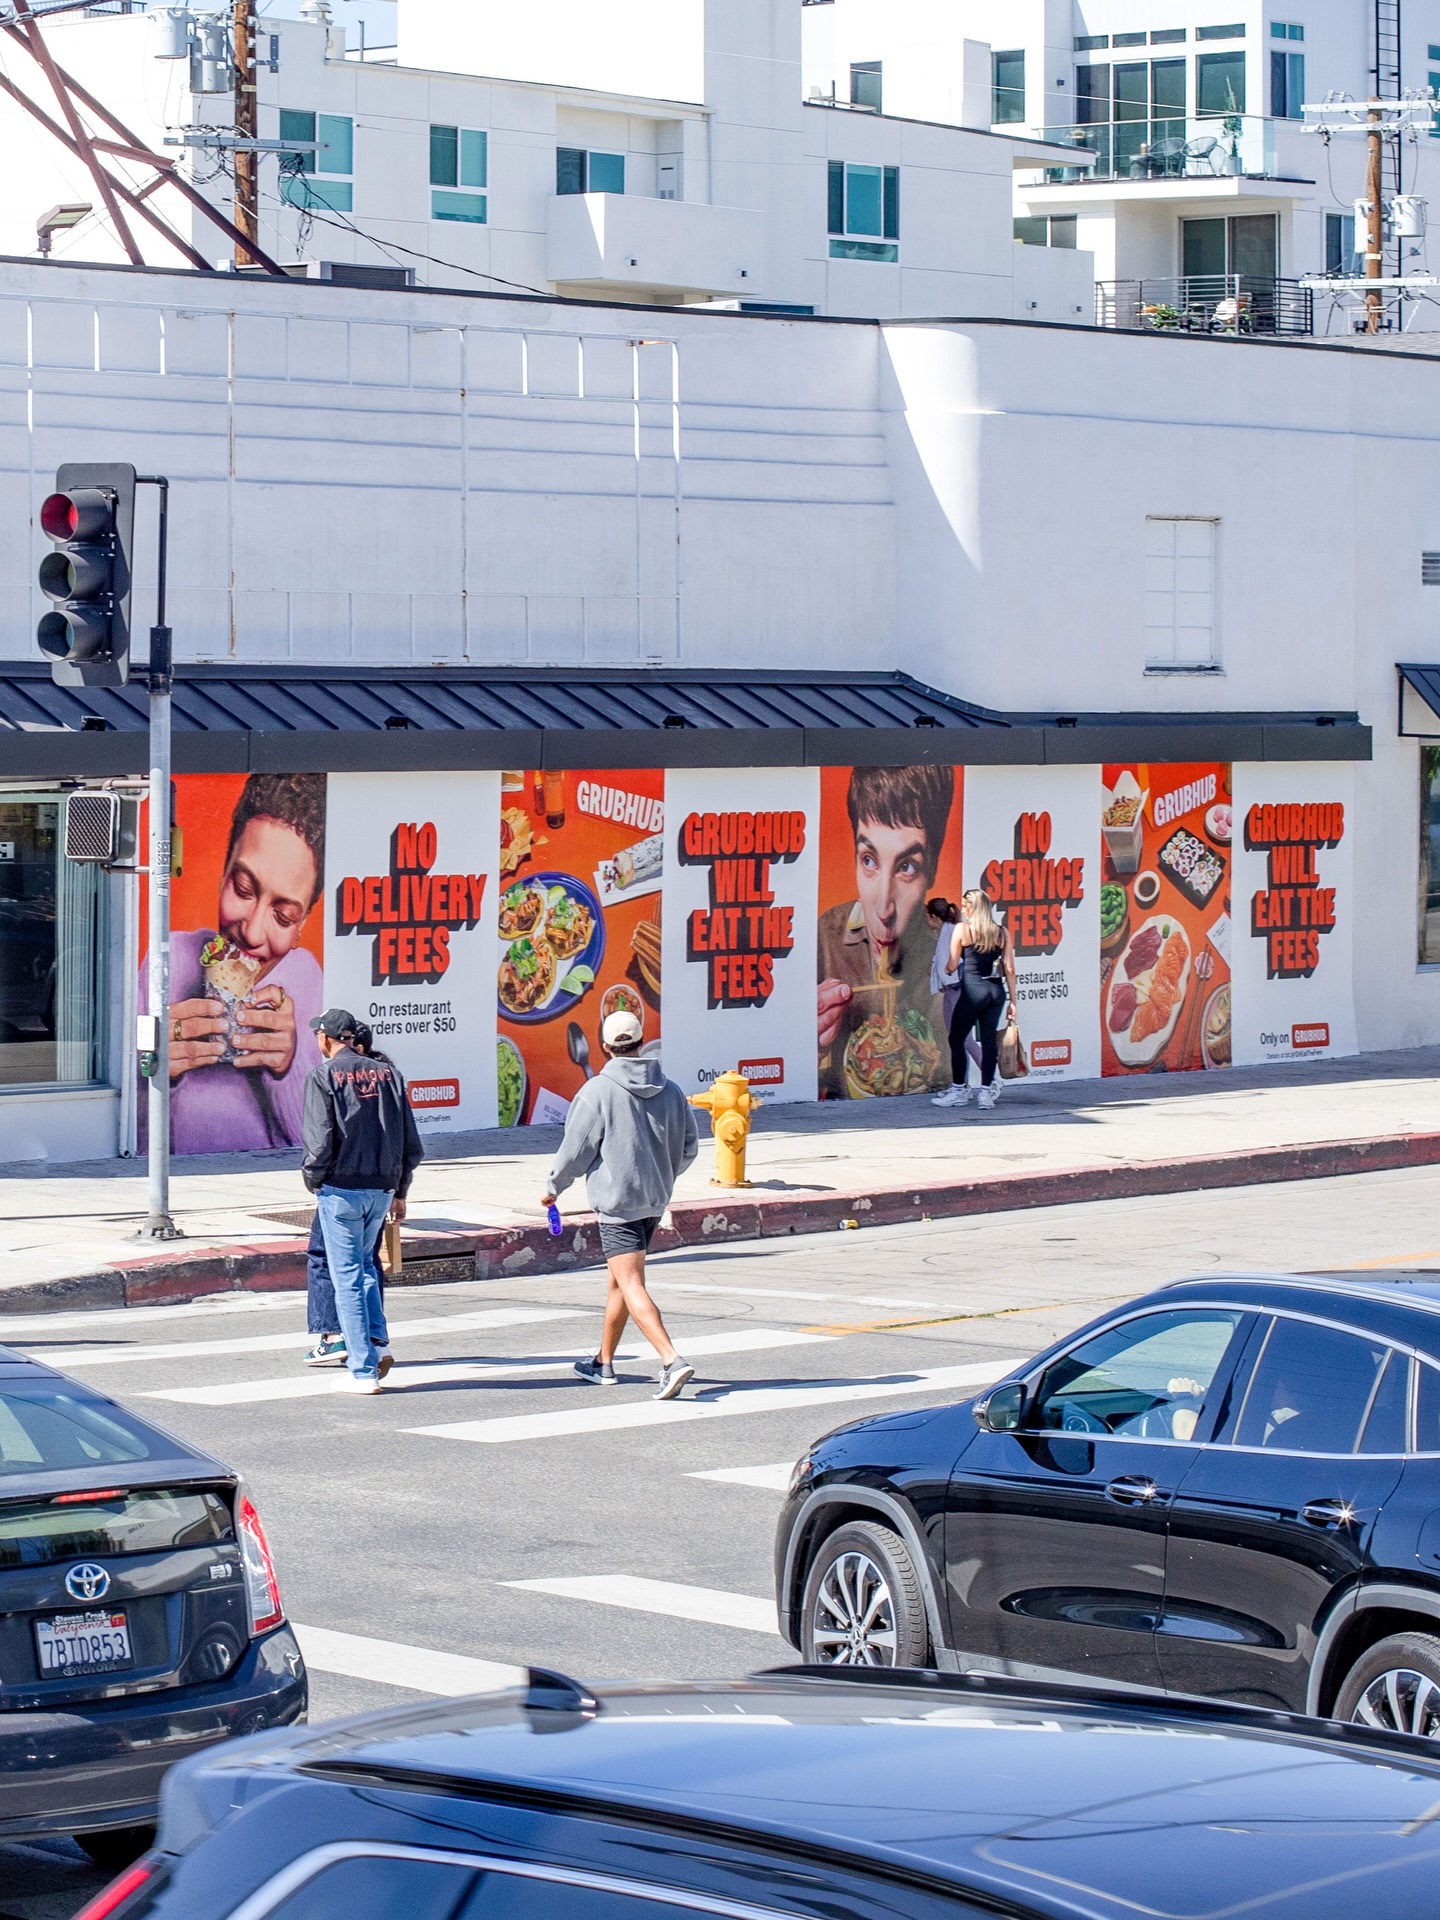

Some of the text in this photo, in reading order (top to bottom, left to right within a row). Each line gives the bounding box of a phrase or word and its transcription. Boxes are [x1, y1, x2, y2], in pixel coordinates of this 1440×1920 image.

[577, 780, 664, 832] GRUBHUB
[1154, 773, 1216, 826] GRUBHUB
[682, 811, 806, 856] GRUBHUB
[1019, 811, 1052, 854] NO
[1248, 803, 1344, 842] GRUBHUB
[395, 821, 438, 870] NO
[1270, 845, 1320, 884] WILL
[341, 873, 488, 925] DELIVERY
[713, 859, 775, 903] WILL
[985, 857, 1085, 903] SERVICE
[1007, 904, 1063, 947] FEES
[1254, 888, 1336, 928] EAT THE
[690, 906, 795, 952] EAT THE
[376, 925, 451, 975] FEES
[1270, 929, 1320, 970] FEES
[712, 953, 774, 999] FEES
[1016, 970, 1064, 985] restaurant
[1028, 988, 1049, 1000] over
[1050, 984, 1068, 1000] $50
[369, 1000, 451, 1018] On restaurant
[371, 1016, 456, 1035] rders over $50
[1034, 1045, 1068, 1060] GRUBHUB
[1260, 1029, 1326, 1047] Only on GRUBHUB
[333, 1068, 392, 1087] FAMOUS
[742, 1064, 780, 1079] GRUBHUB
[411, 1085, 456, 1102] GRUBHUB
[76, 1662, 117, 1675] TOYOTA
